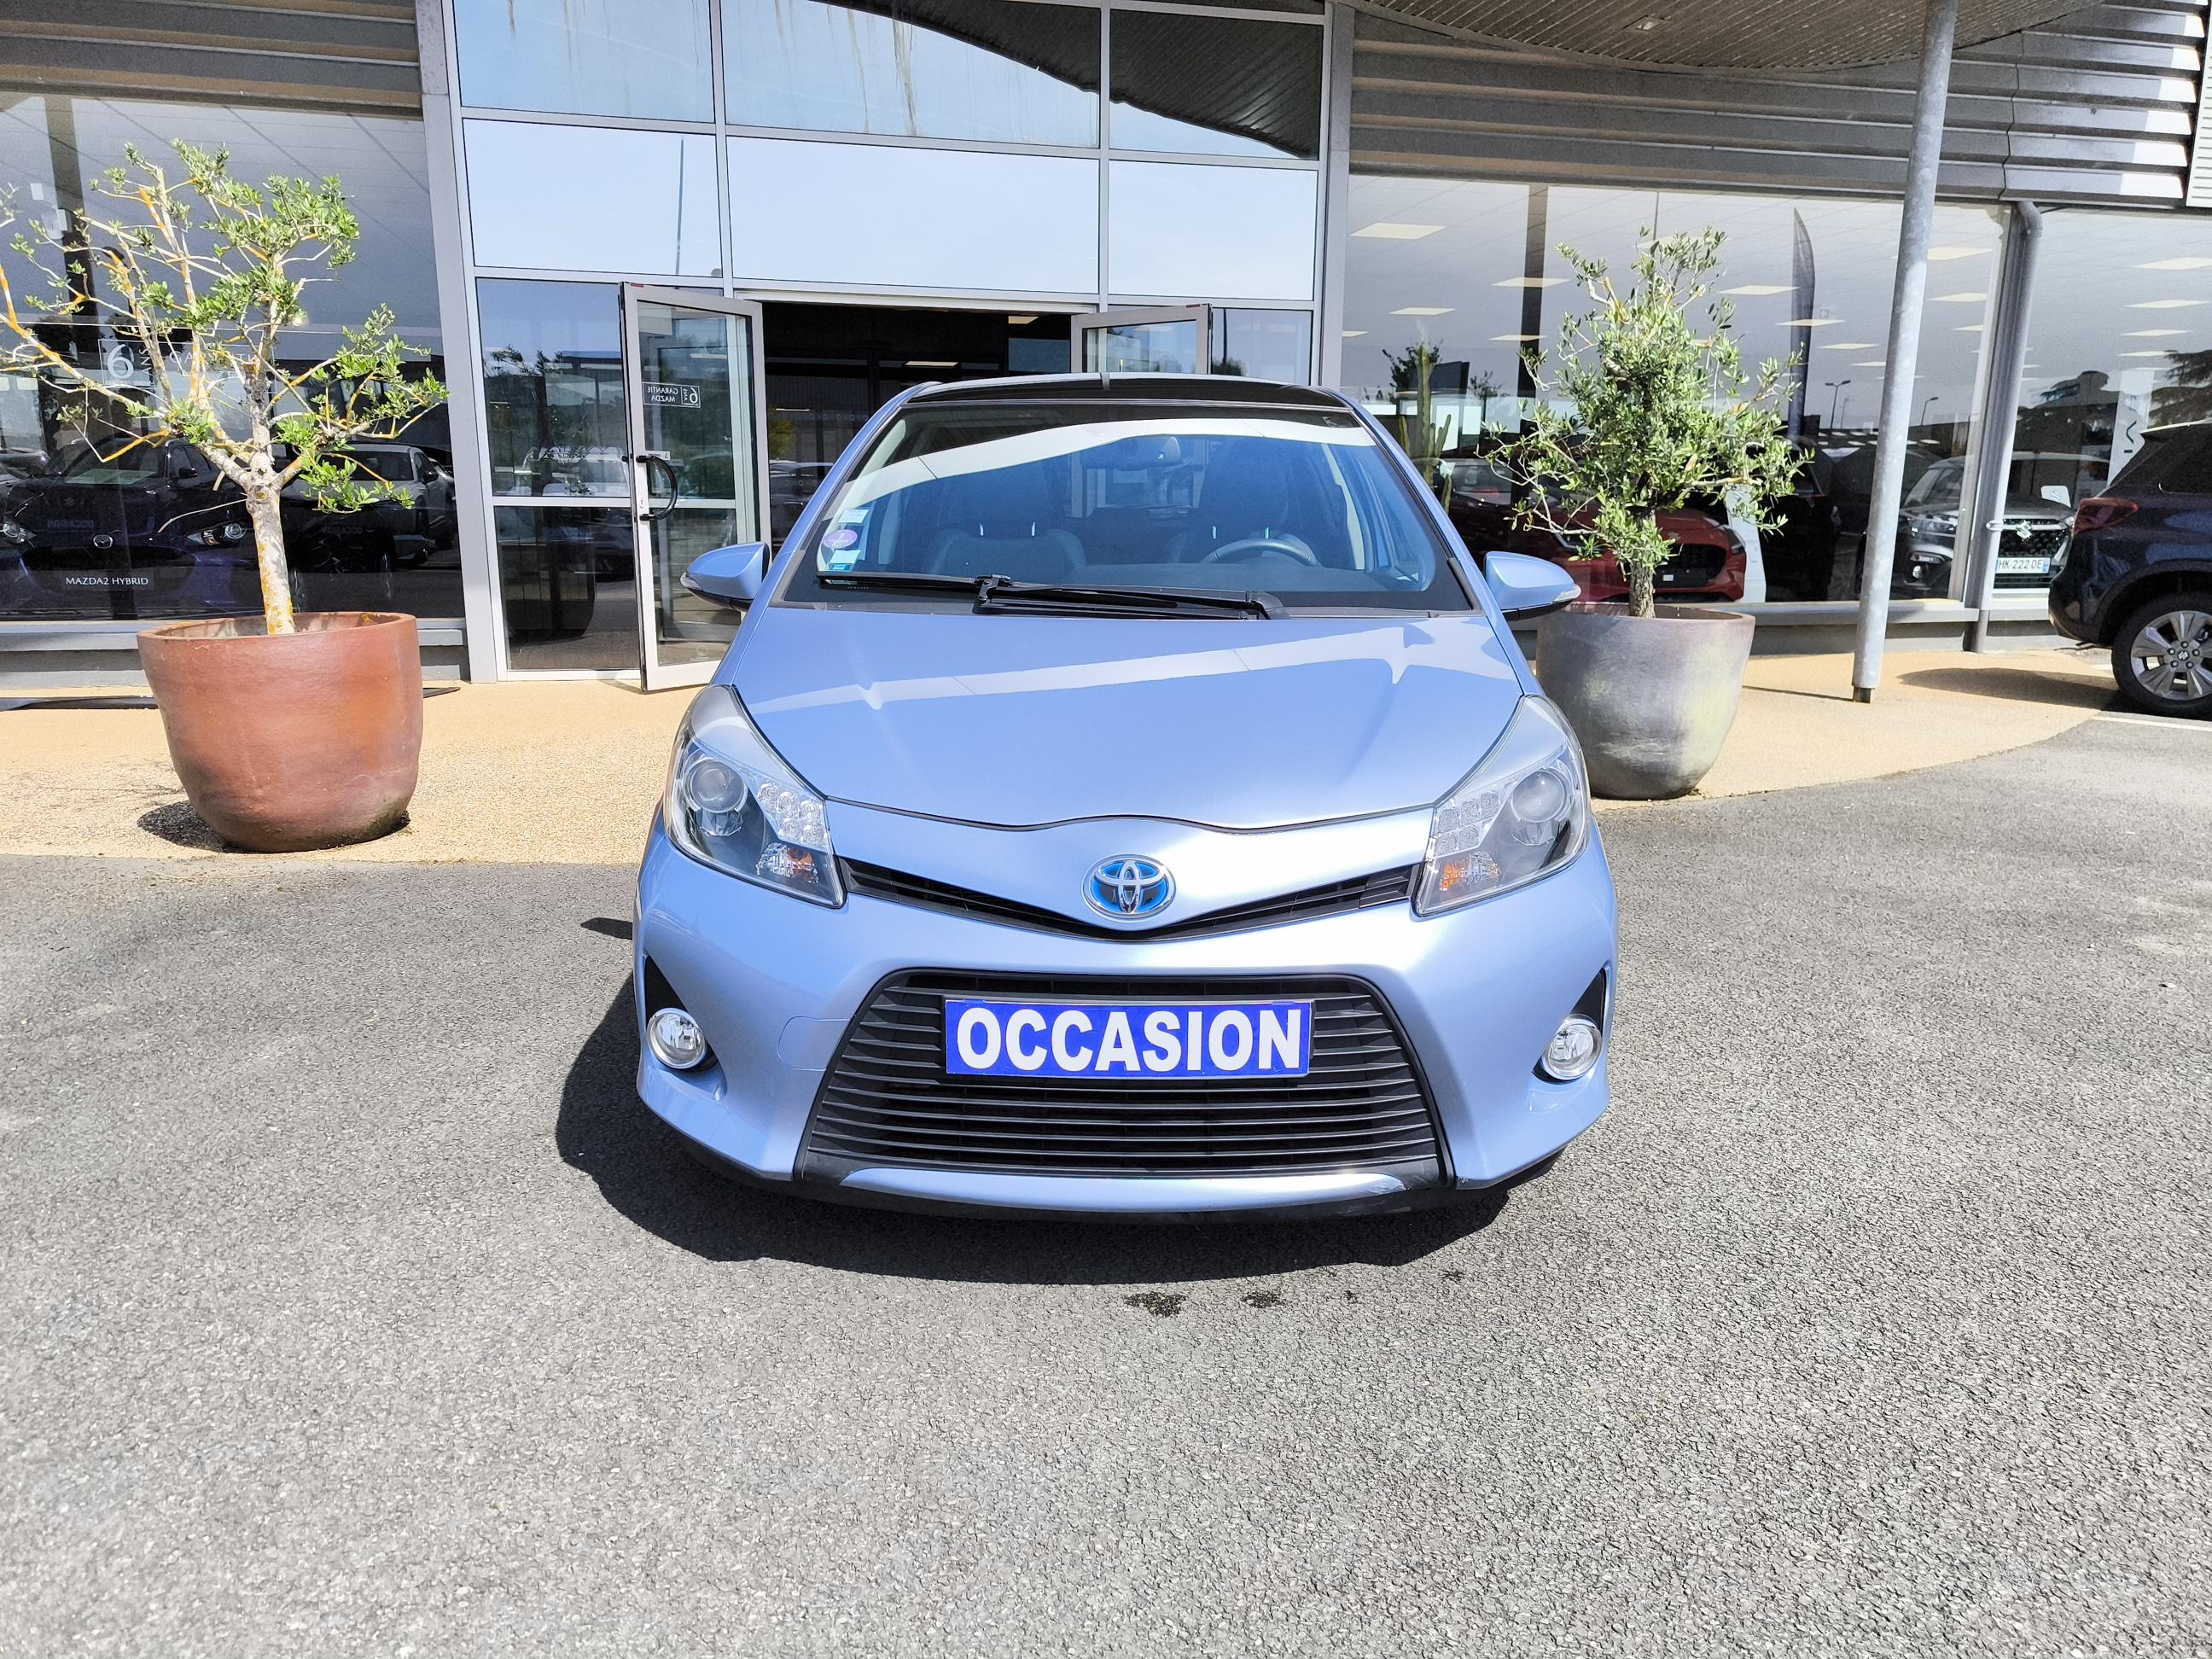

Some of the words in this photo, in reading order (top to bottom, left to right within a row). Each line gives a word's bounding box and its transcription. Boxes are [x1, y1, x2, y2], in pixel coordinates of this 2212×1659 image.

[108, 344, 134, 379] 6
[66, 577, 110, 585] MAZDA2
[112, 577, 148, 585] HYBRID
[956, 1007, 1301, 1073] OCCASION
